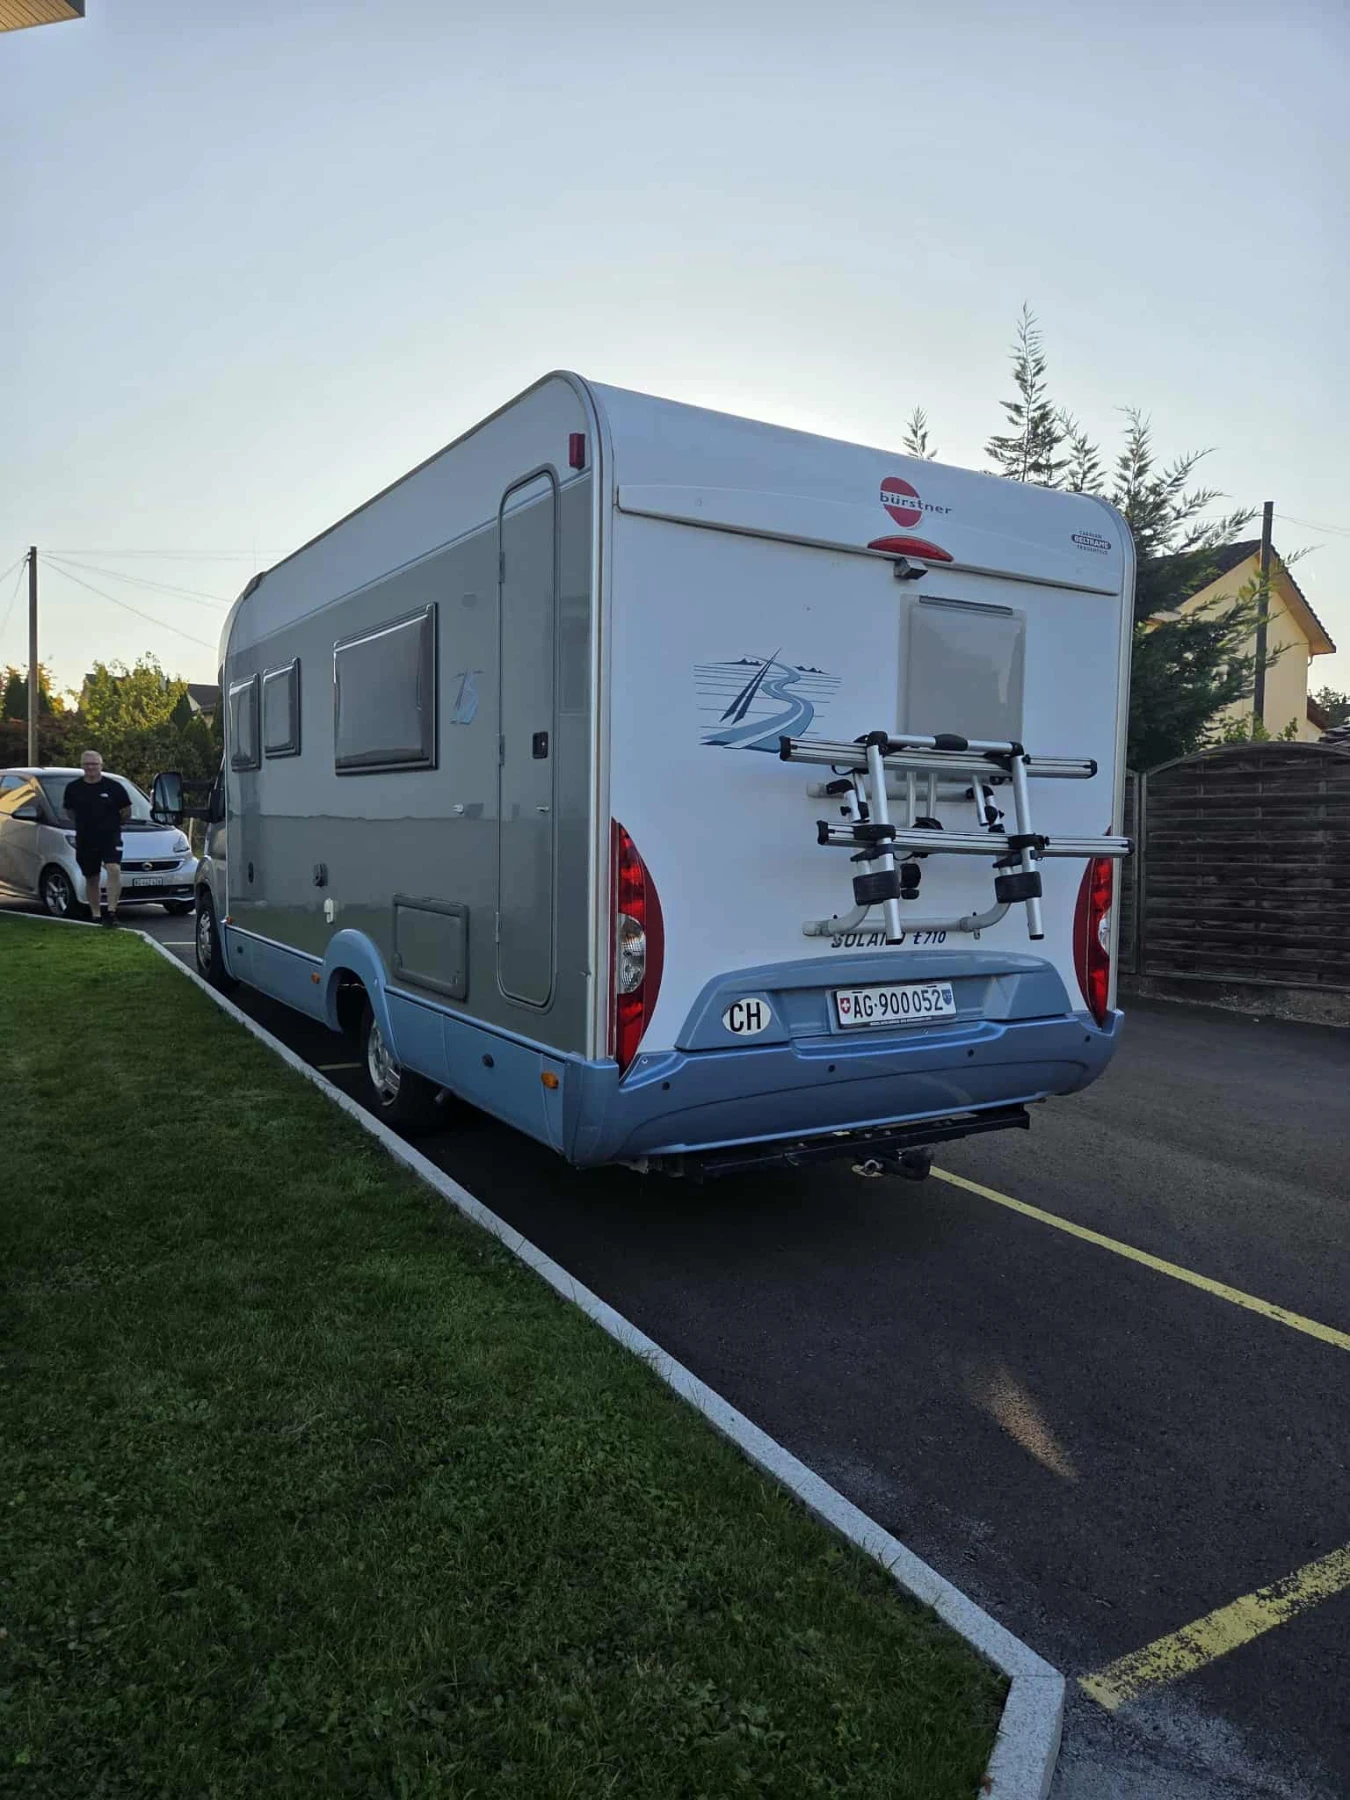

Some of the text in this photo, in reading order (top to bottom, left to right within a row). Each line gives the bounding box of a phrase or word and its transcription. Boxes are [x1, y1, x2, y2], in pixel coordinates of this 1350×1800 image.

[880, 491, 952, 514] bürstner
[913, 930, 946, 945] t710
[729, 1003, 761, 1032] CH
